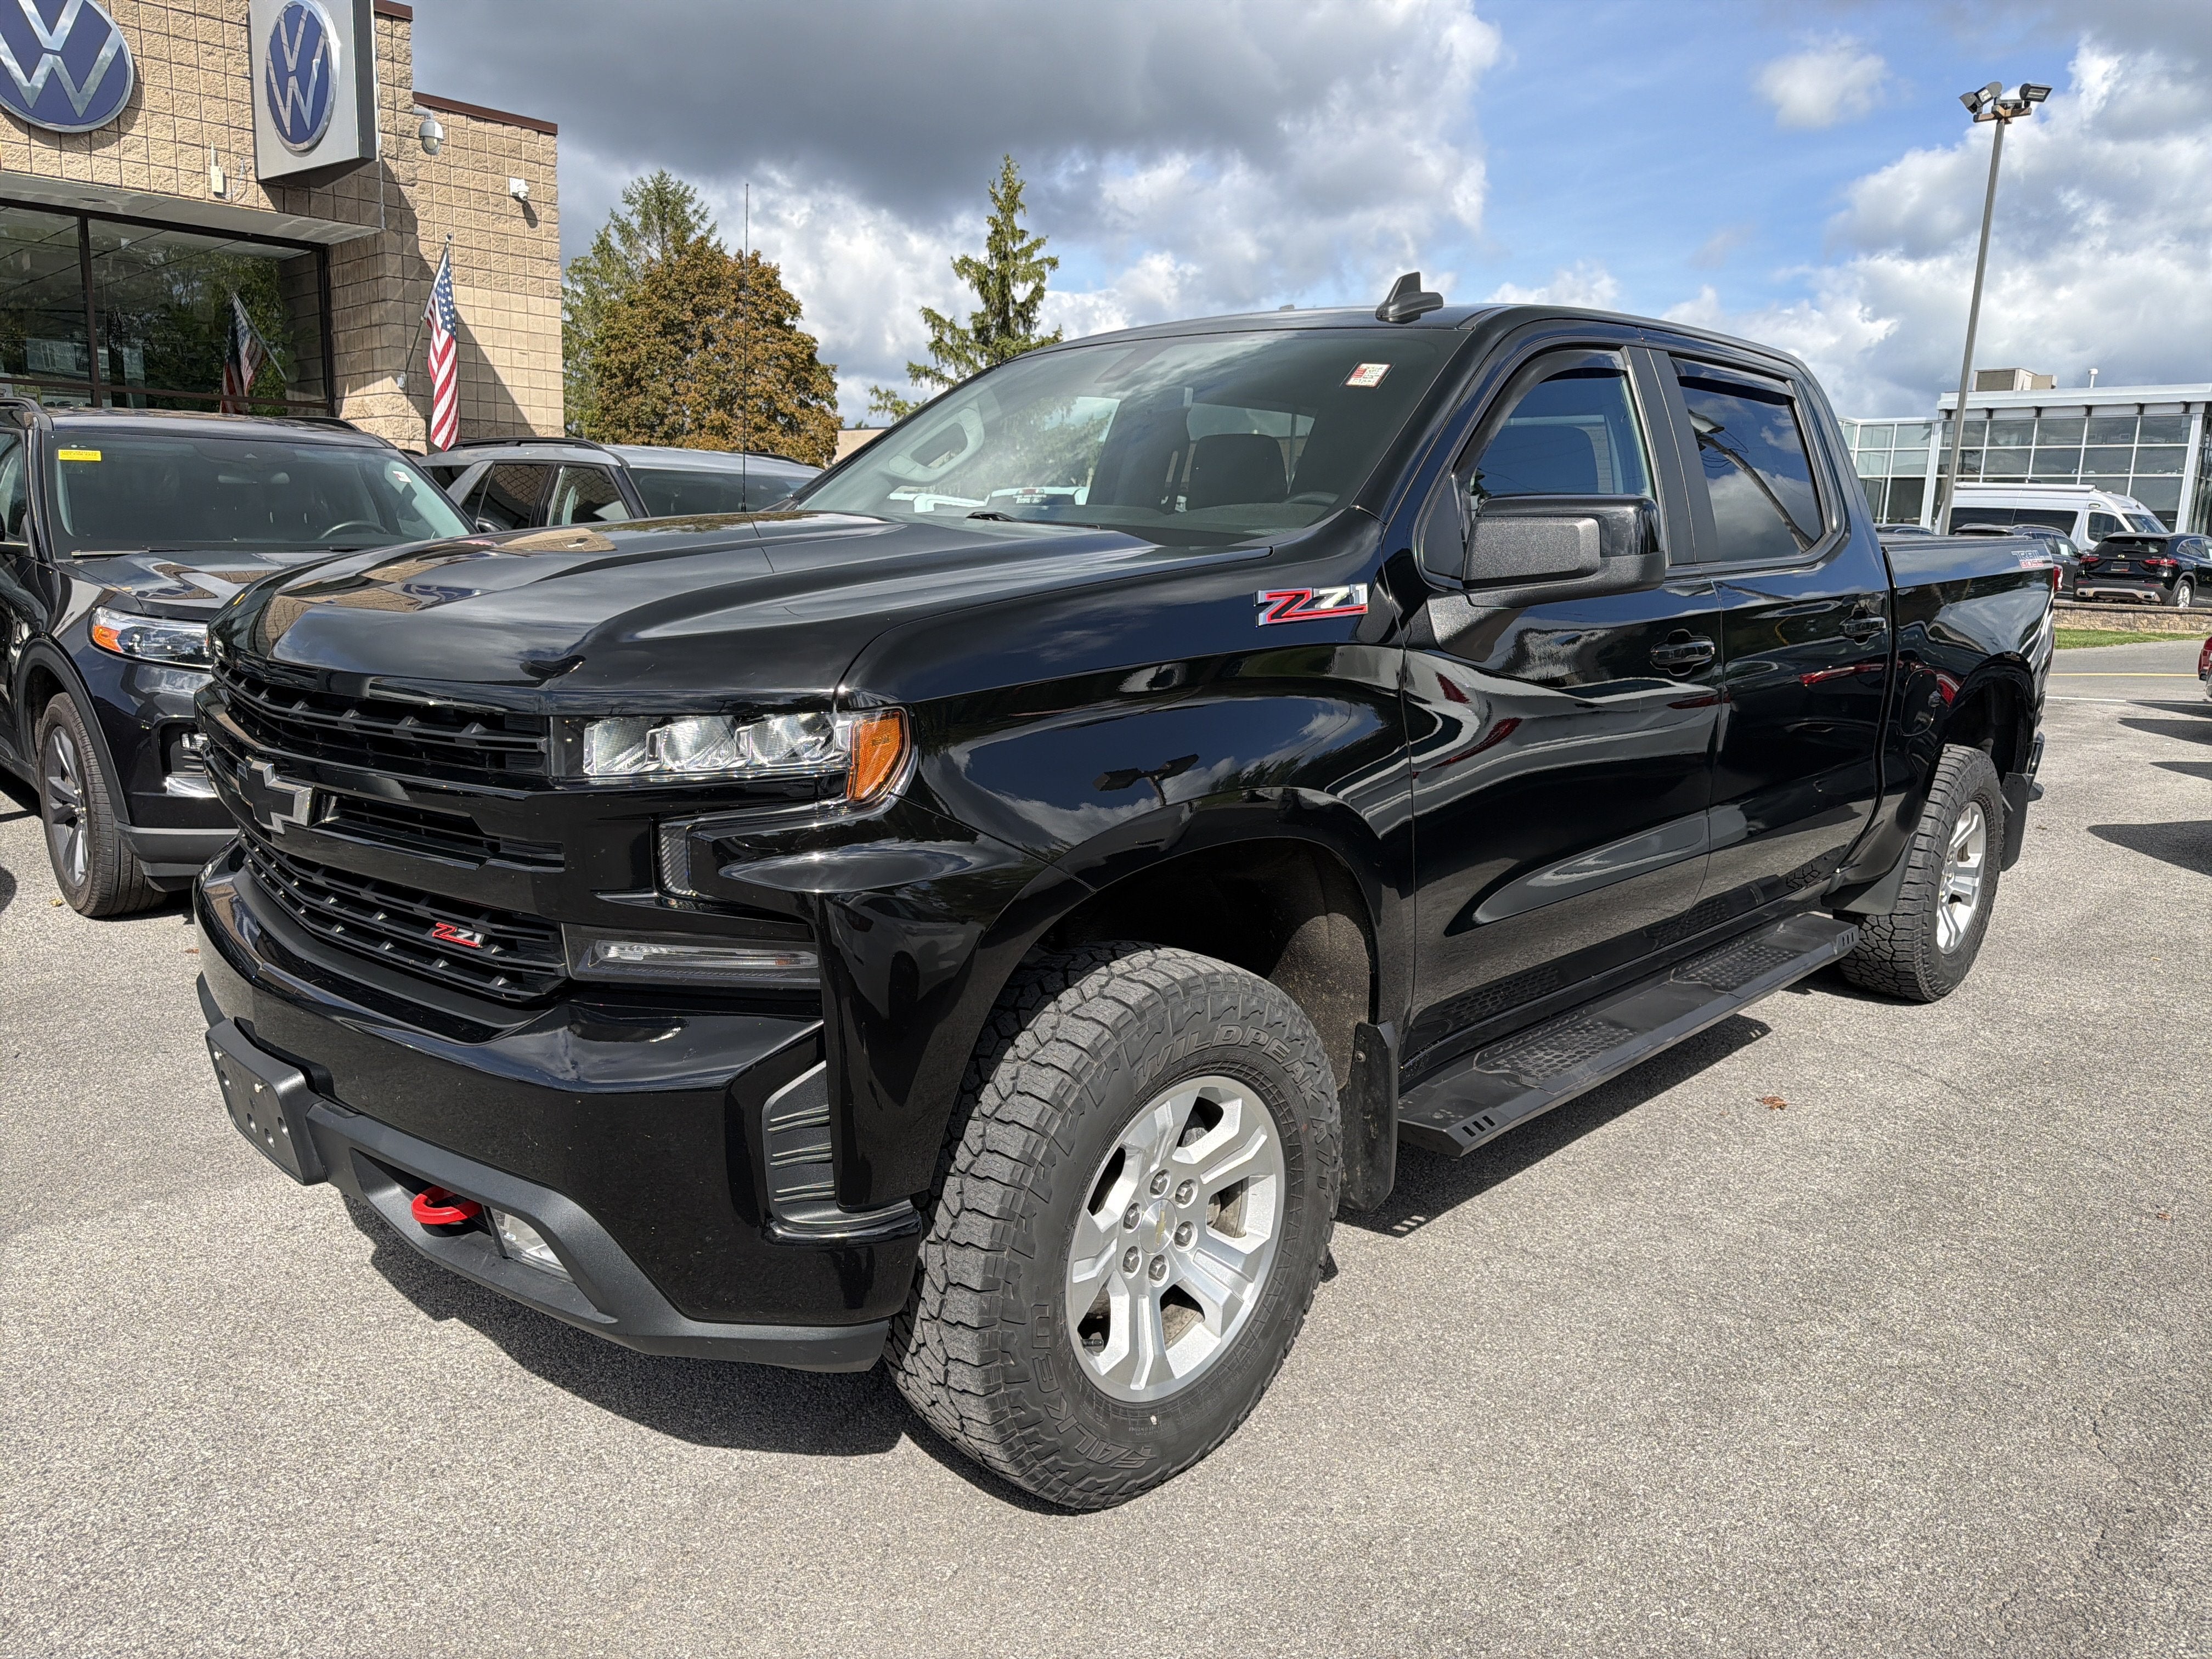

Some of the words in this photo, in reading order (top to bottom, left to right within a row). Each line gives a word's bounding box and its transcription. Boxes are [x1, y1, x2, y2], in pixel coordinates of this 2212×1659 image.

[266, 5, 326, 137] VW
[2011, 550, 2045, 560] TRAIL
[2019, 560, 2045, 569] BOSS
[1254, 583, 1368, 627] Z71
[432, 922, 484, 948] Z71
[1135, 1024, 1320, 1109] WILDPEAK
[1031, 1304, 1156, 1469] FALKEN
